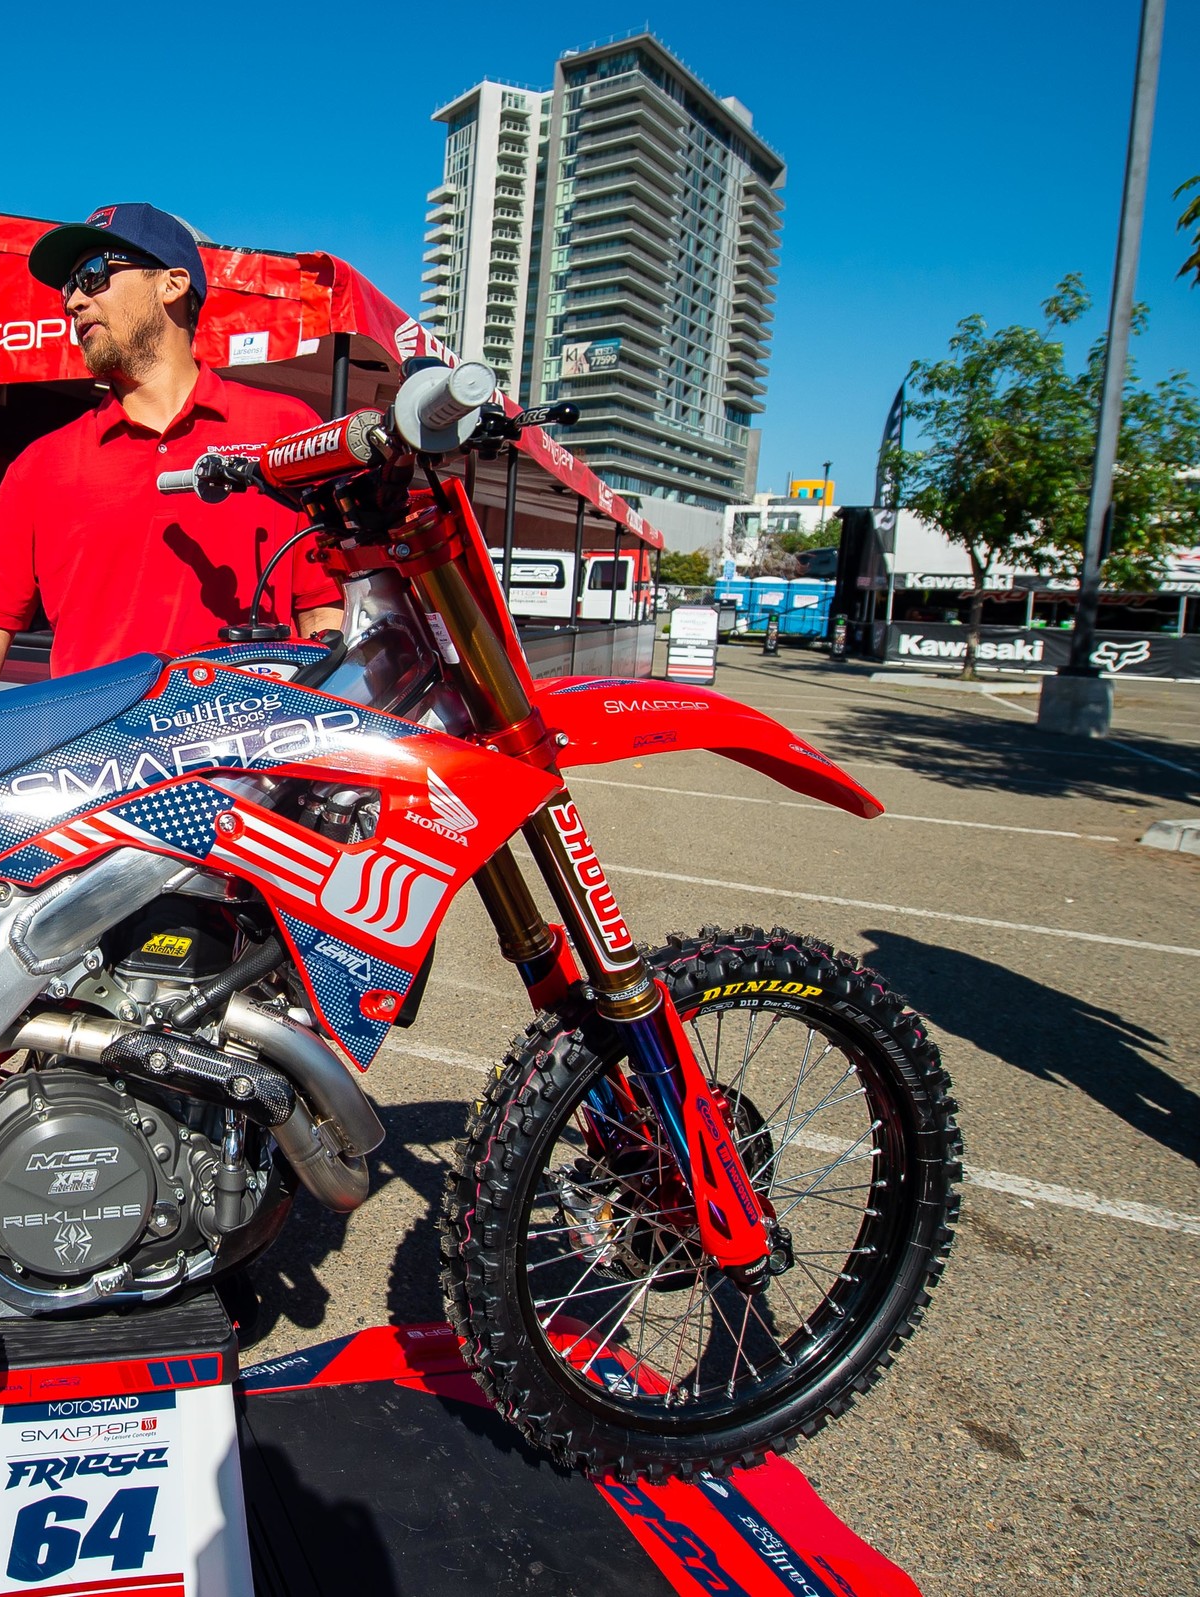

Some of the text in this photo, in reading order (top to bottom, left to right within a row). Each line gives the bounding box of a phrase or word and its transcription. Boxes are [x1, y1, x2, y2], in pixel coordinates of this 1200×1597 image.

[516, 408, 550, 424] ARC
[207, 444, 261, 452] SMARTOP
[266, 427, 343, 469] RENTHAL
[148, 692, 283, 733] bullfrog
[231, 710, 266, 727] spas
[603, 700, 710, 714] SMARTOP
[10, 710, 361, 797] SMARTOP
[404, 809, 469, 847] HONDA
[548, 803, 633, 953] SHOWA
[699, 980, 823, 1003] DUNLOP
[25, 1147, 119, 1171] MCR
[3, 1204, 141, 1229] REKLUSE
[48, 1397, 139, 1416] MOTOSTAND
[21, 1421, 139, 1443] SMARTOP
[132, 1431, 157, 1439] Concepts
[5, 1447, 169, 1491] FRIESE
[6, 1486, 159, 1582] 64
